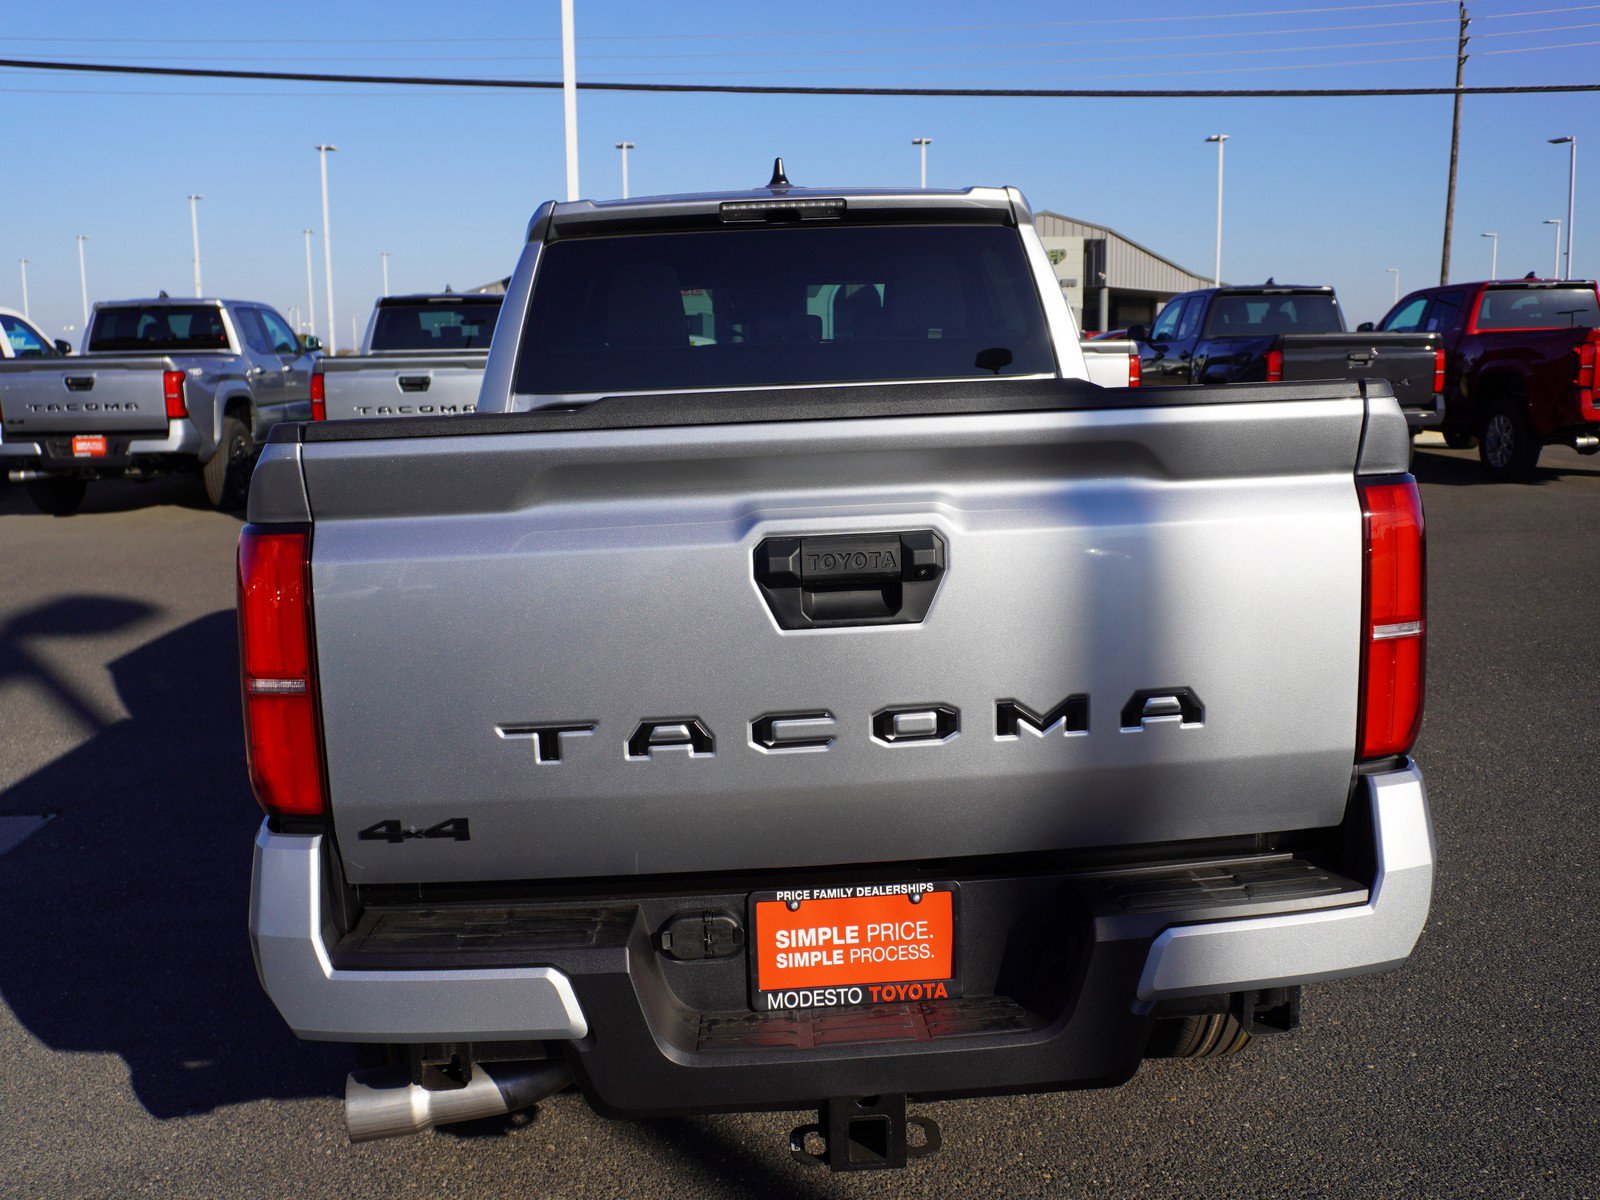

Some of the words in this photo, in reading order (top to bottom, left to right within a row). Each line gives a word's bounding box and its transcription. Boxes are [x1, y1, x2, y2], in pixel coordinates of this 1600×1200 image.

[26, 402, 139, 413] TACOMA
[353, 404, 477, 417] TACOMA
[806, 550, 897, 571] TOYOTA
[493, 686, 1205, 764] TACOMA
[776, 891, 810, 901] PRICE
[813, 888, 853, 899] FAMILY
[856, 883, 934, 897] DEALERSHIPS
[775, 926, 860, 949] SIMPLE
[866, 921, 934, 943] PRICE.
[775, 949, 844, 969] SIMPLE
[850, 943, 935, 964] PROCESS.
[767, 987, 863, 1010] MODESTO
[868, 983, 949, 1003] TOYOTA
